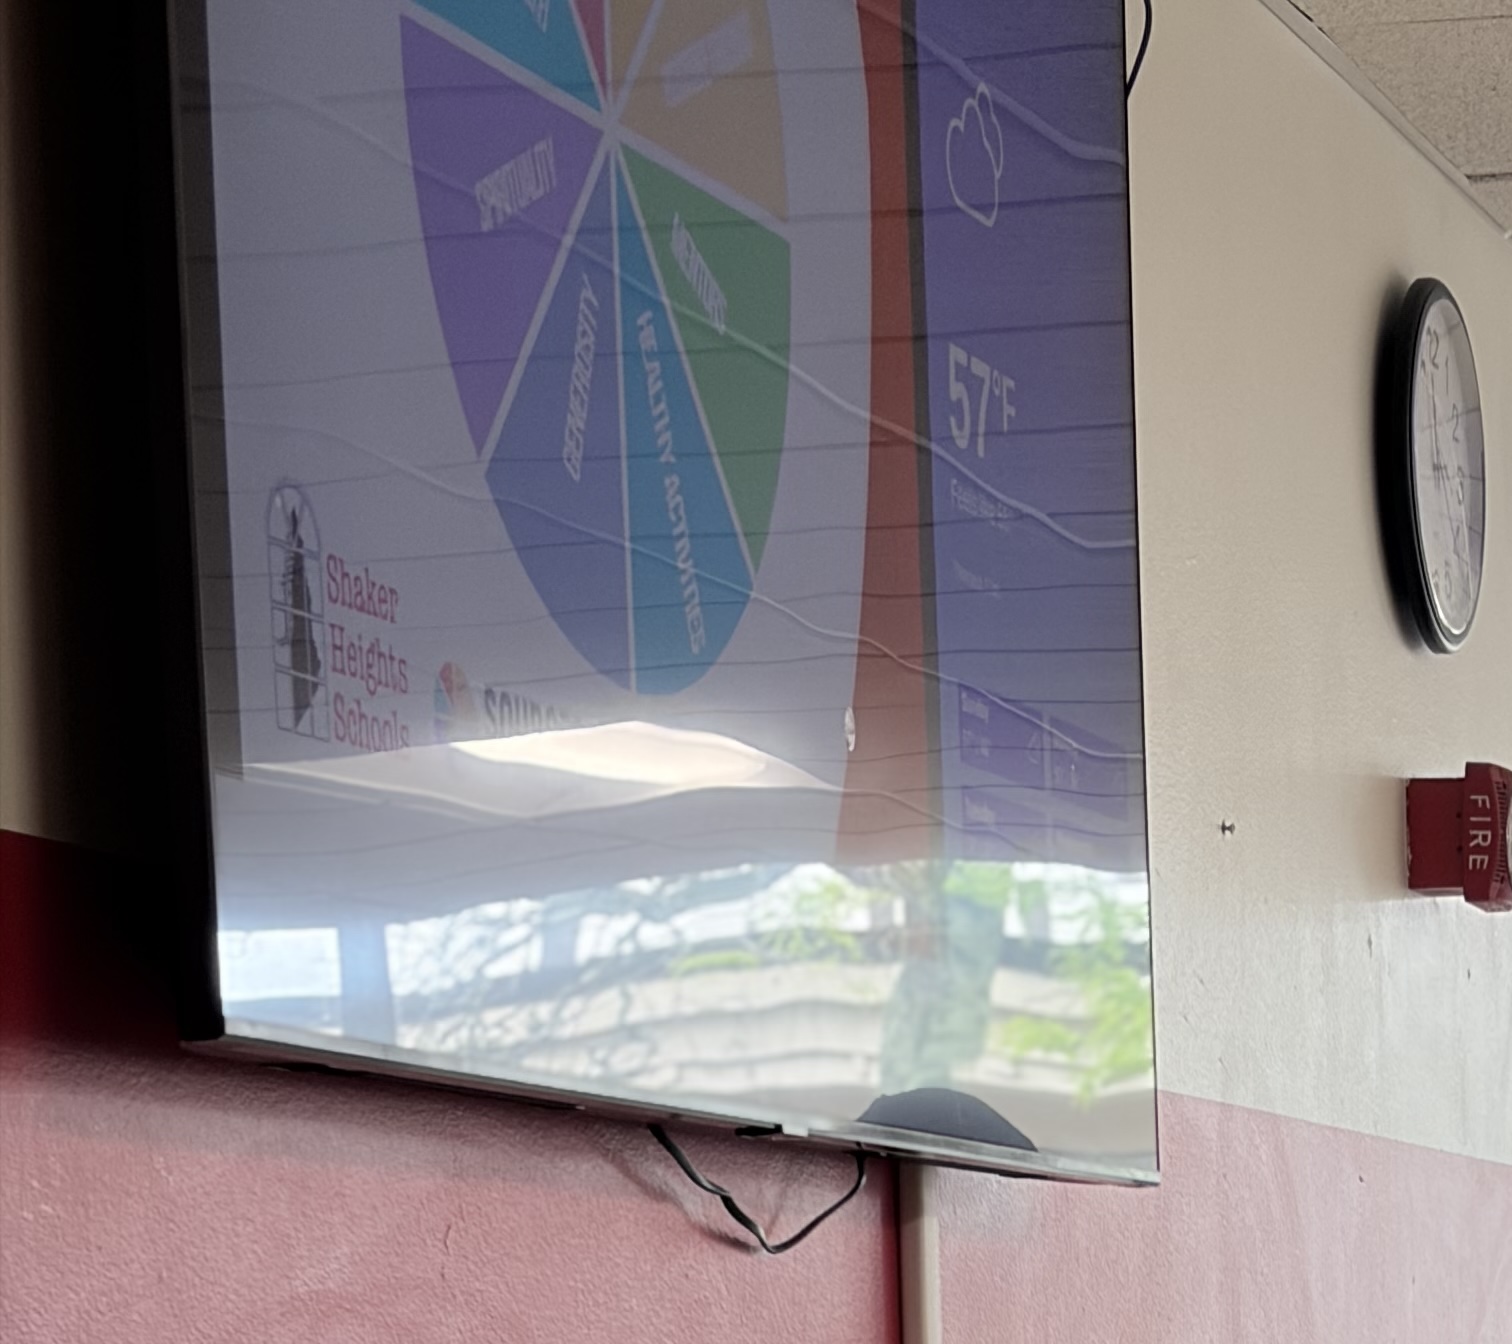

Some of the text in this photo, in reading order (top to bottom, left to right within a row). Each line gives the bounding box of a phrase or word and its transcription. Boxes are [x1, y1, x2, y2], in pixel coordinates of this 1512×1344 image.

[563, 270, 599, 483] GENEROSITY
[636, 309, 707, 656] HEALTHY ACTIVITIES
[325, 553, 399, 625] Shaker
[328, 622, 410, 697] Heights
[332, 691, 411, 756] Schools
[1468, 794, 1493, 871] FIRE
